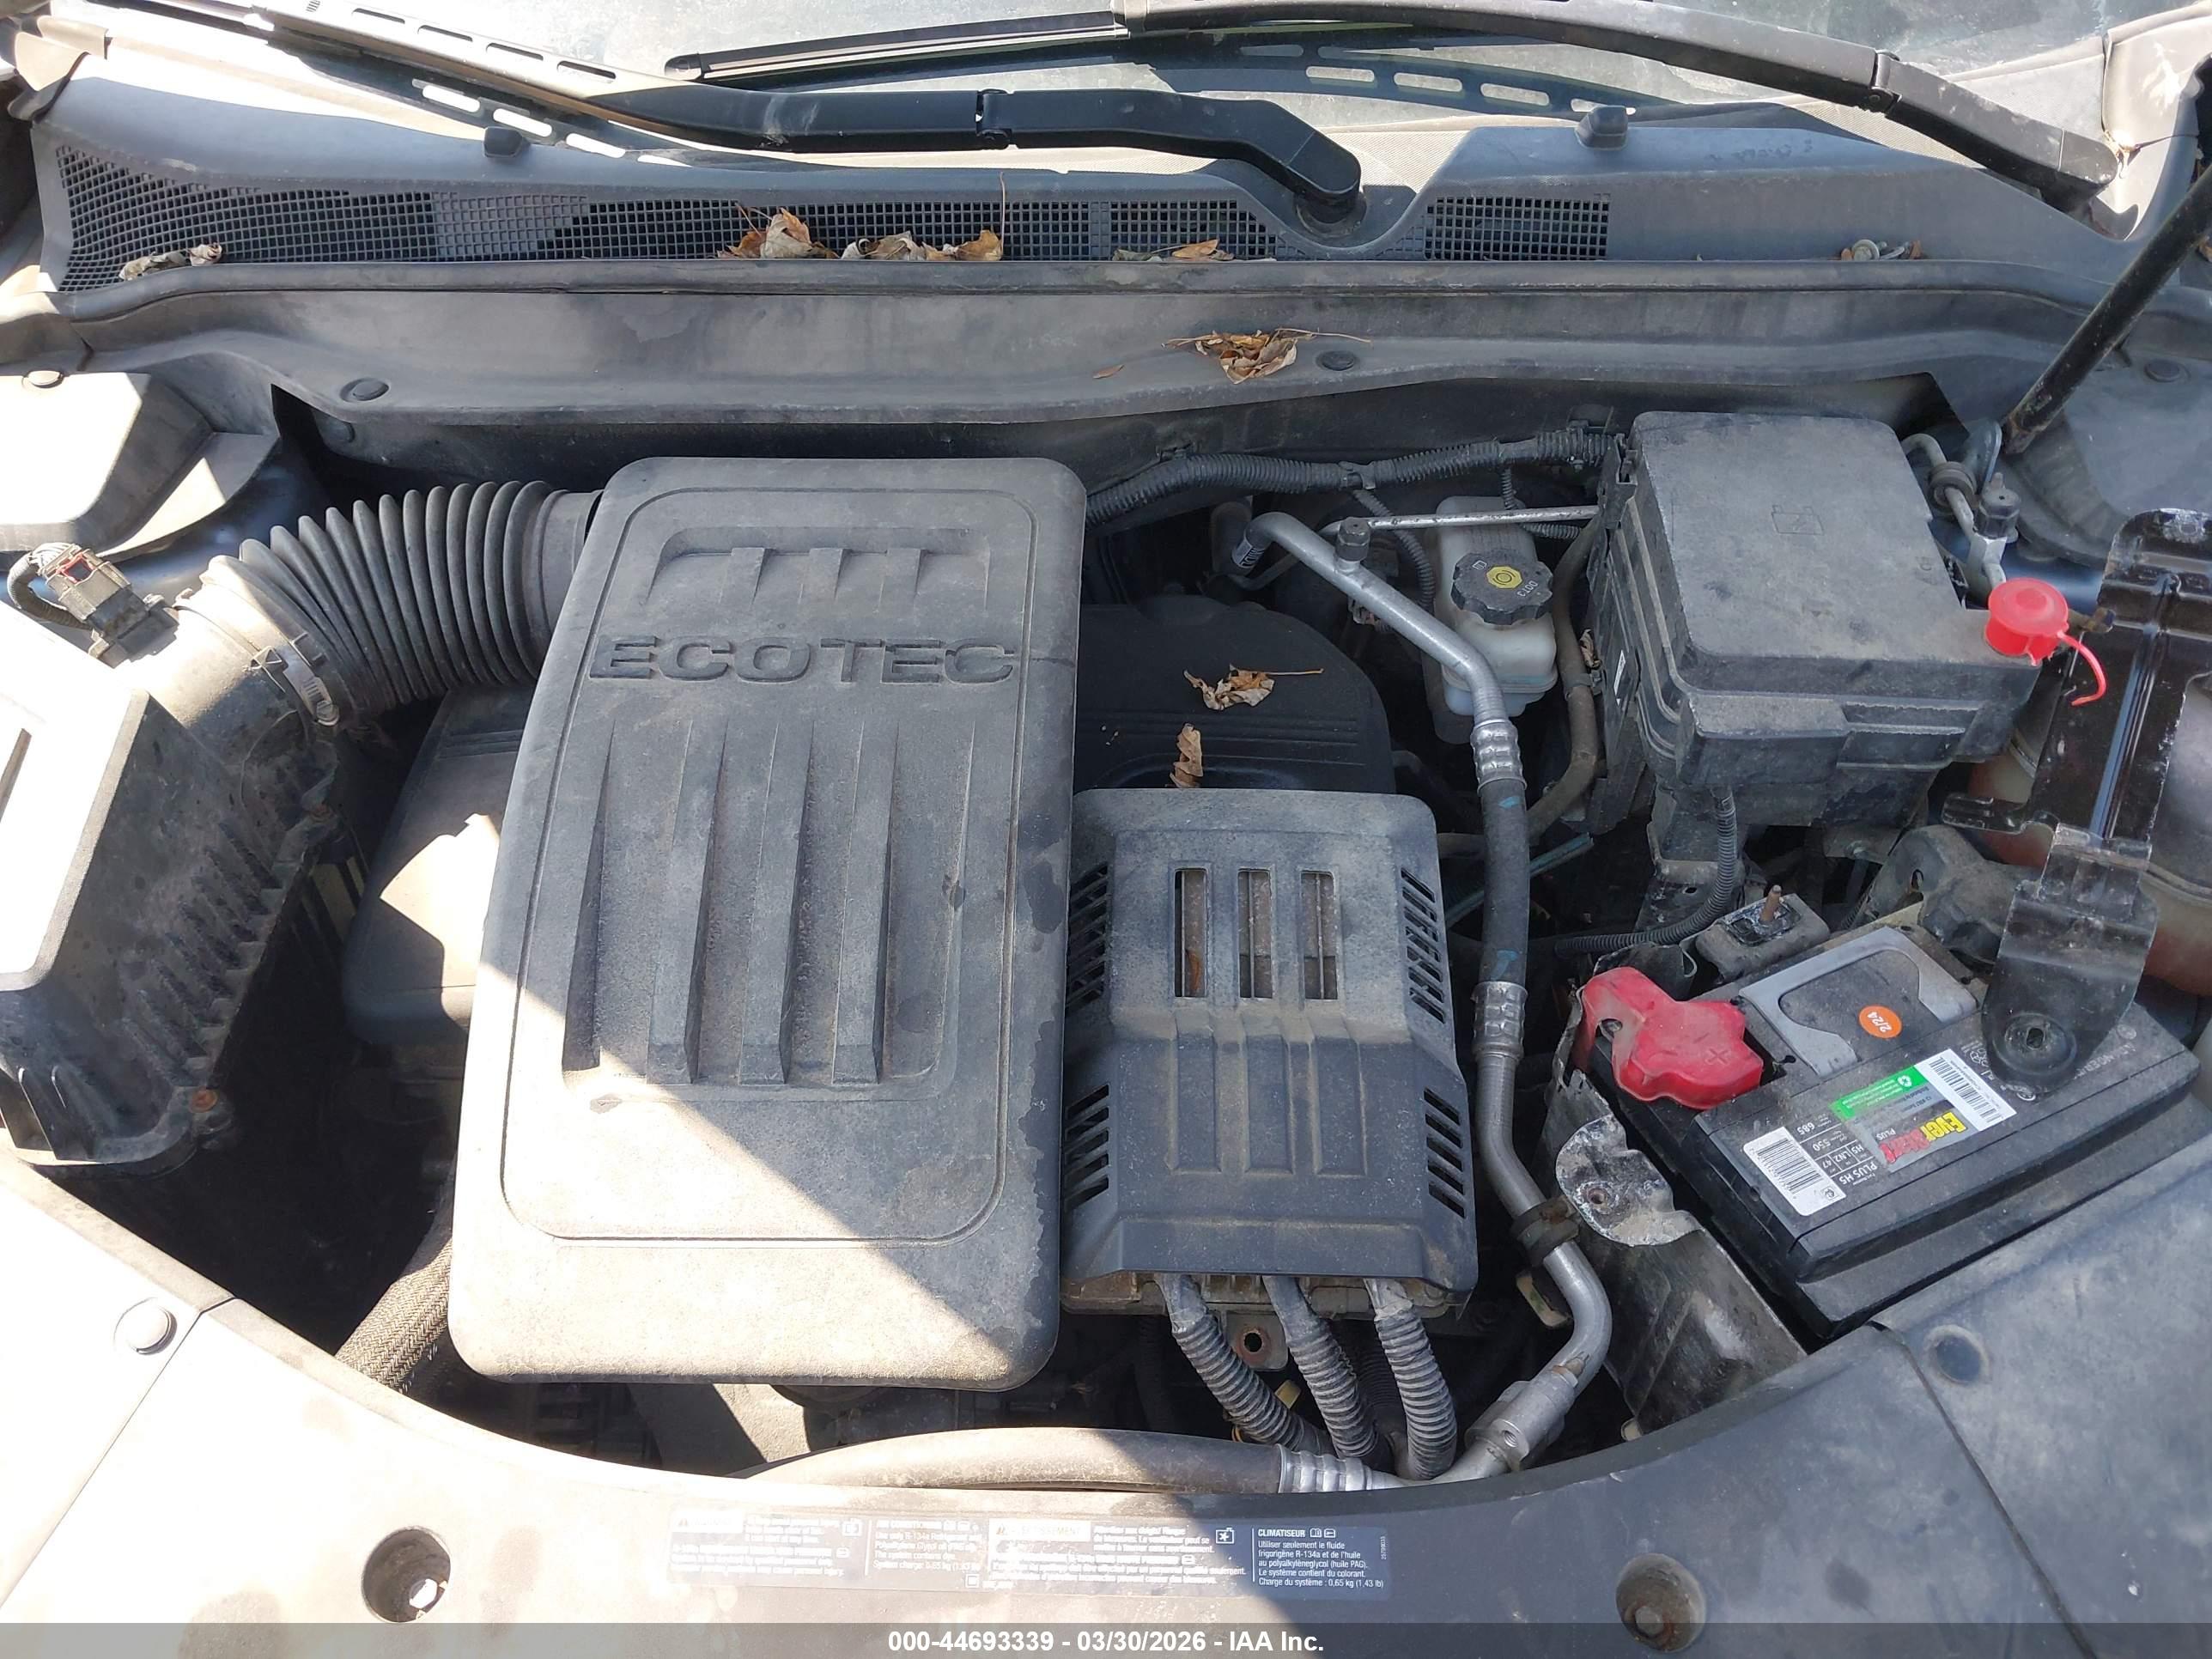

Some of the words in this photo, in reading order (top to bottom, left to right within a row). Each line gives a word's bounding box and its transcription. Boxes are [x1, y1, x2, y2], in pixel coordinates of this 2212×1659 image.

[589, 635, 1015, 684] ECOTEC
[1867, 1012, 1893, 1033] 2/24
[1796, 1121, 1815, 1135] 685
[1875, 1127, 1897, 1140] PLUS
[1812, 1139, 1832, 1152] 550
[1832, 1151, 1851, 1163] LN2
[1822, 1159, 1832, 1169] 47
[1852, 1161, 1878, 1178] PLUS
[1838, 1173, 1855, 1185] H5
[1258, 1528, 1306, 1538] CLIMATISEUR
[1258, 1540, 1281, 1548] Utiliser
[1282, 1540, 1317, 1549] seulement
[1258, 1549, 1294, 1559] frigorigène
[1330, 1560, 1349, 1569] (huile
[1350, 1560, 1369, 1570] PAG).
[1268, 1570, 1297, 1578] système
[1258, 1577, 1283, 1588] Charge
[1294, 1578, 1323, 1588] système
[1328, 1579, 1344, 1588] 0,65
[1345, 1579, 1354, 1589] kg
[1355, 1579, 1374, 1588] (1.43
[1375, 1579, 1384, 1589] lb)
